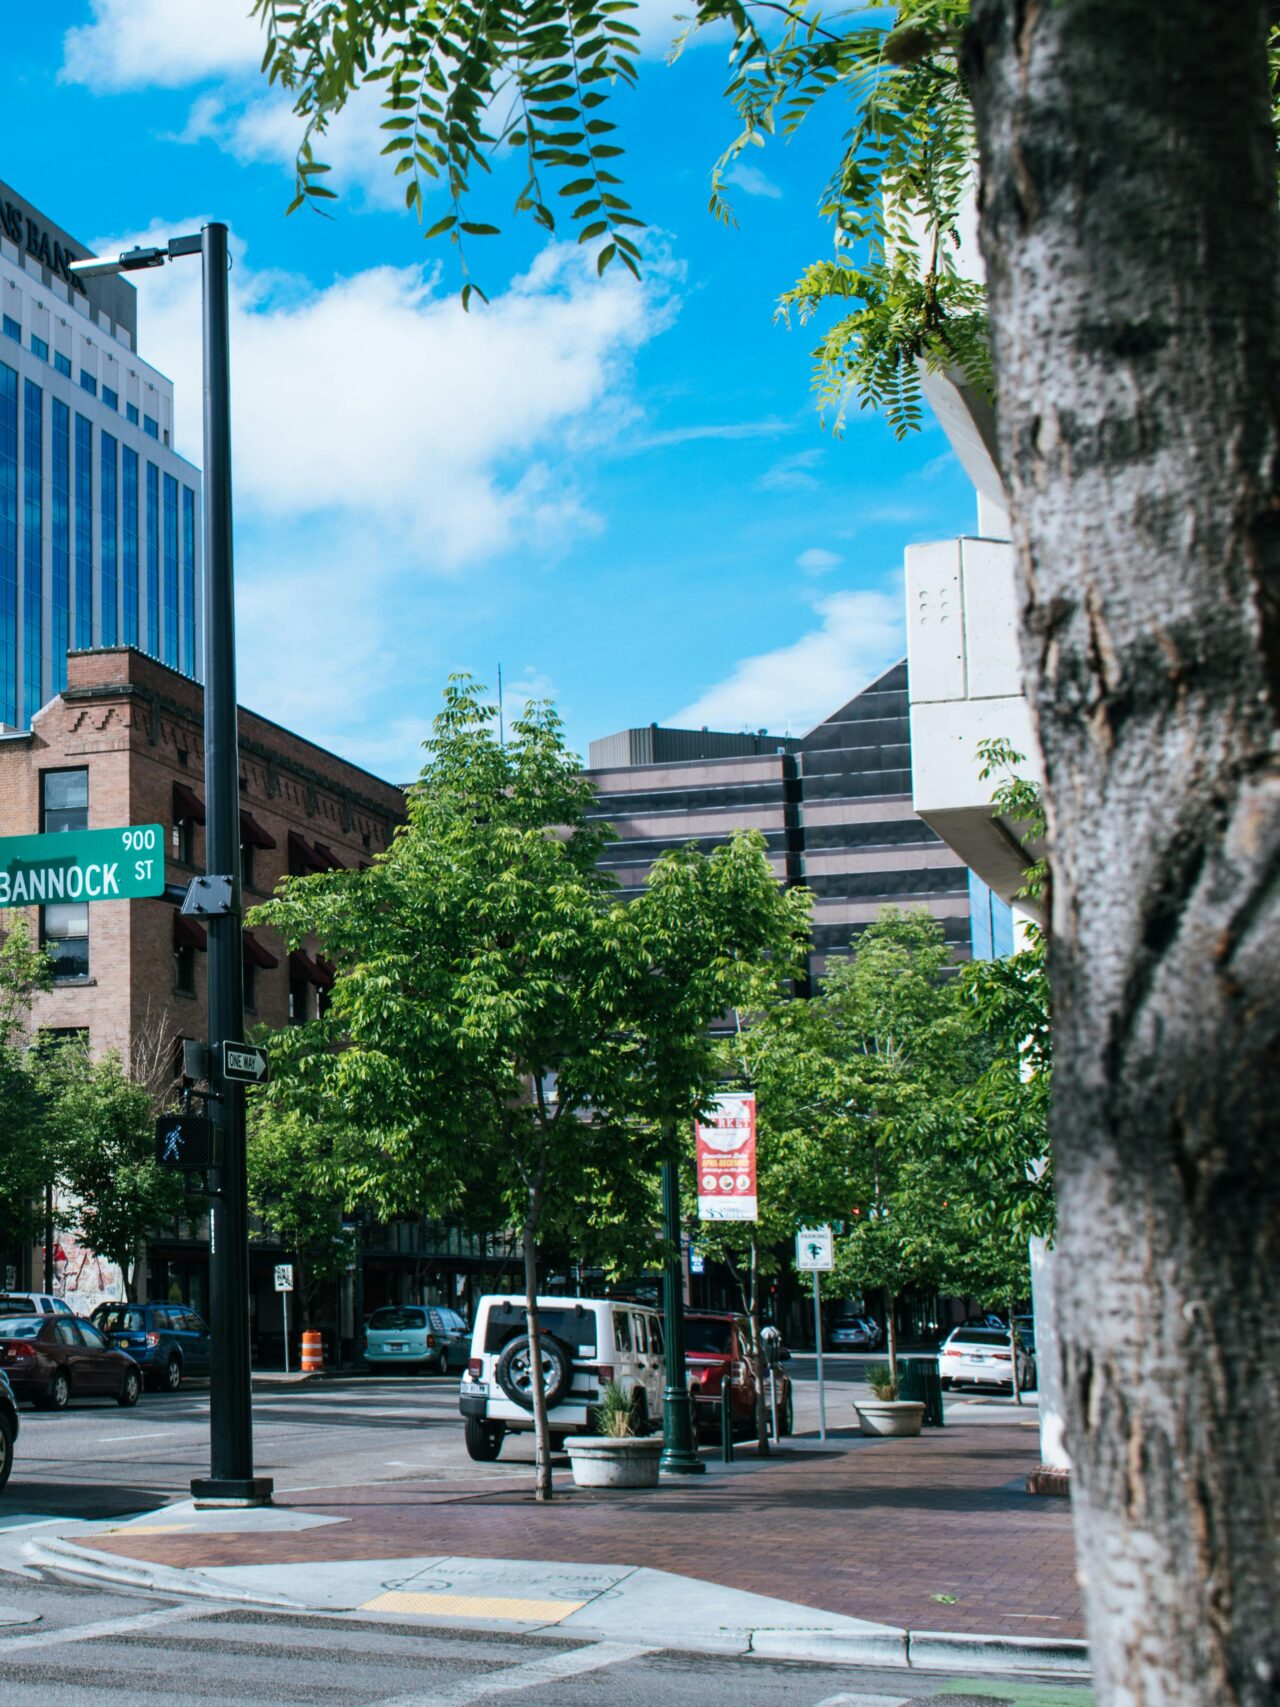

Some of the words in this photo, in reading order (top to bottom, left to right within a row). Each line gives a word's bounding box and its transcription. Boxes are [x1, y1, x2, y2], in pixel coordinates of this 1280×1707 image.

[122, 830, 155, 850] 900
[135, 860, 154, 880] ST
[229, 1053, 242, 1069] ONE
[243, 1056, 256, 1070] WAY
[700, 1118, 751, 1128] RKET
[276, 1265, 290, 1274] ONE
